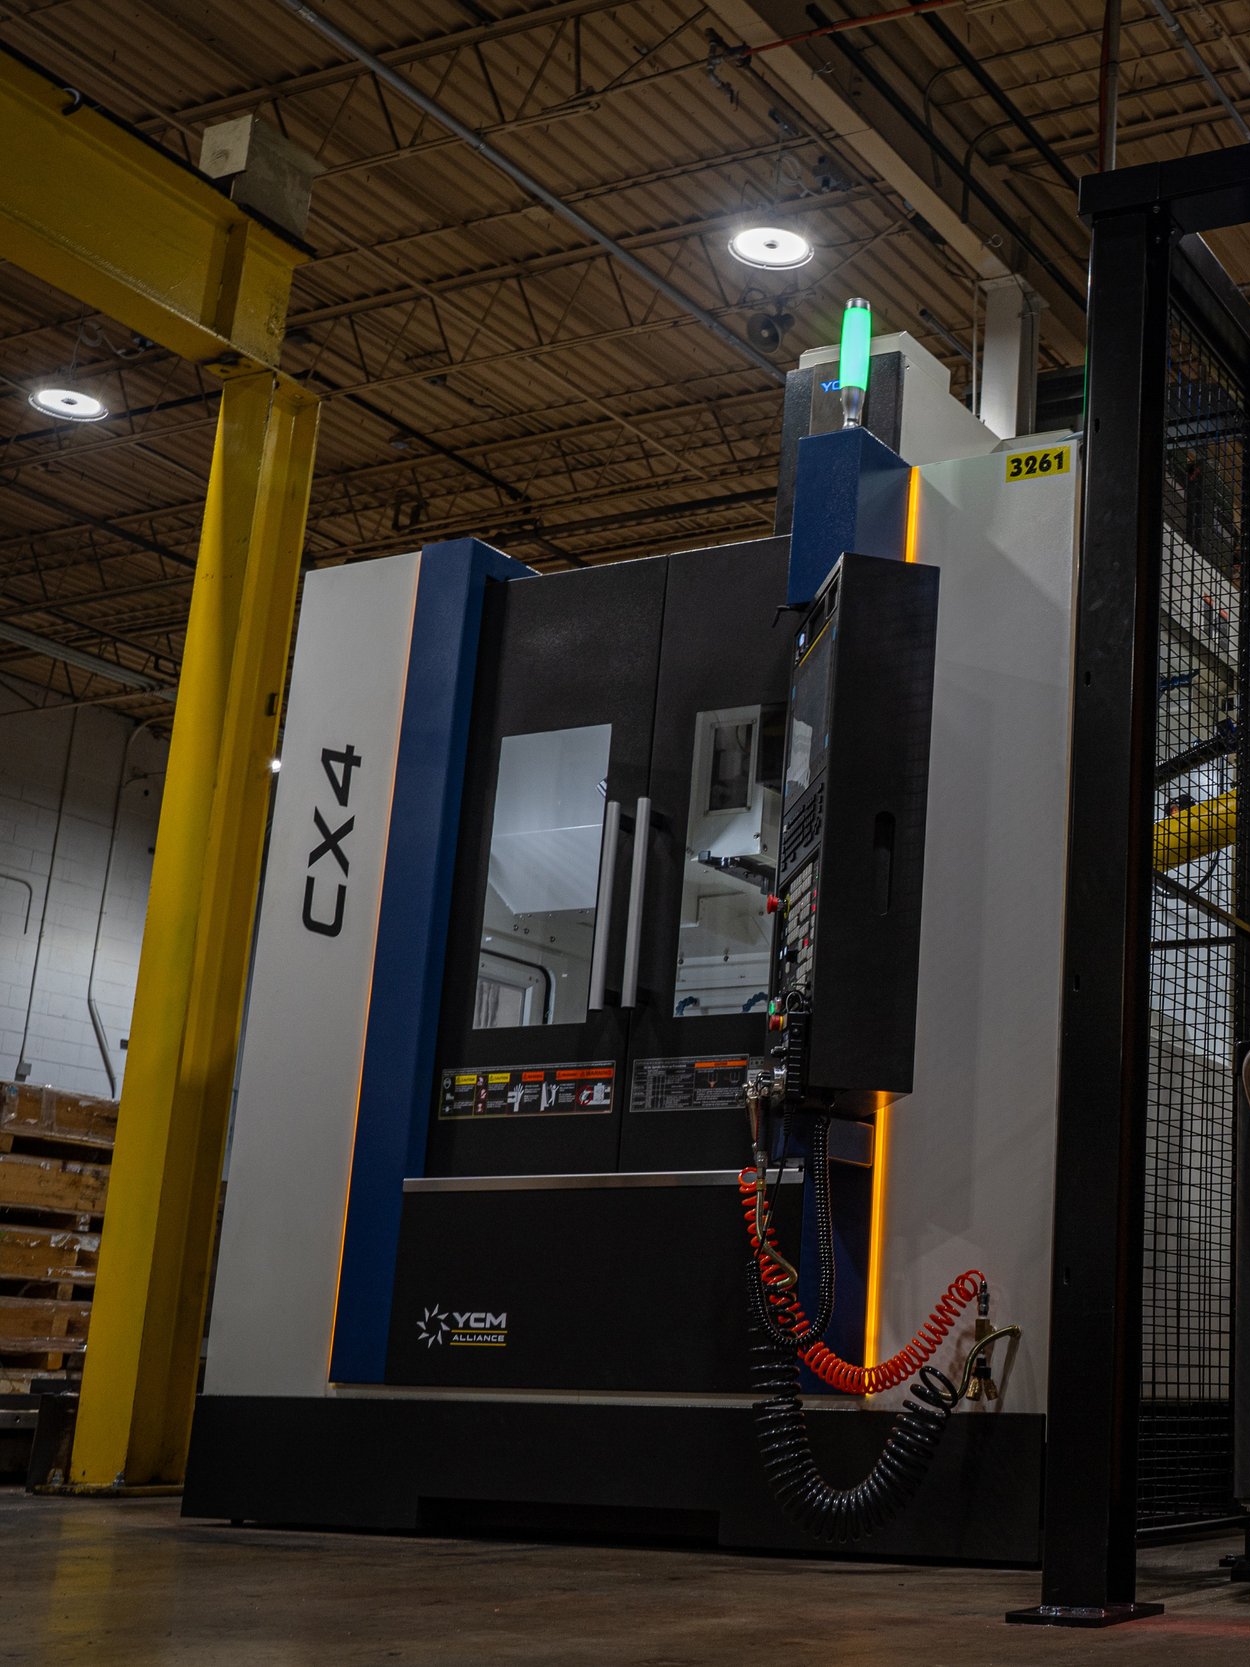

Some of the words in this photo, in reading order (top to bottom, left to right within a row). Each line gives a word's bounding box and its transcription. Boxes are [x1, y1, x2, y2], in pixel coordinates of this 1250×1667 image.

[820, 380, 841, 393] YC
[1009, 450, 1065, 477] 3261
[302, 744, 362, 938] CX4
[452, 1312, 507, 1329] YCM
[452, 1334, 505, 1343] ALLIANCE
